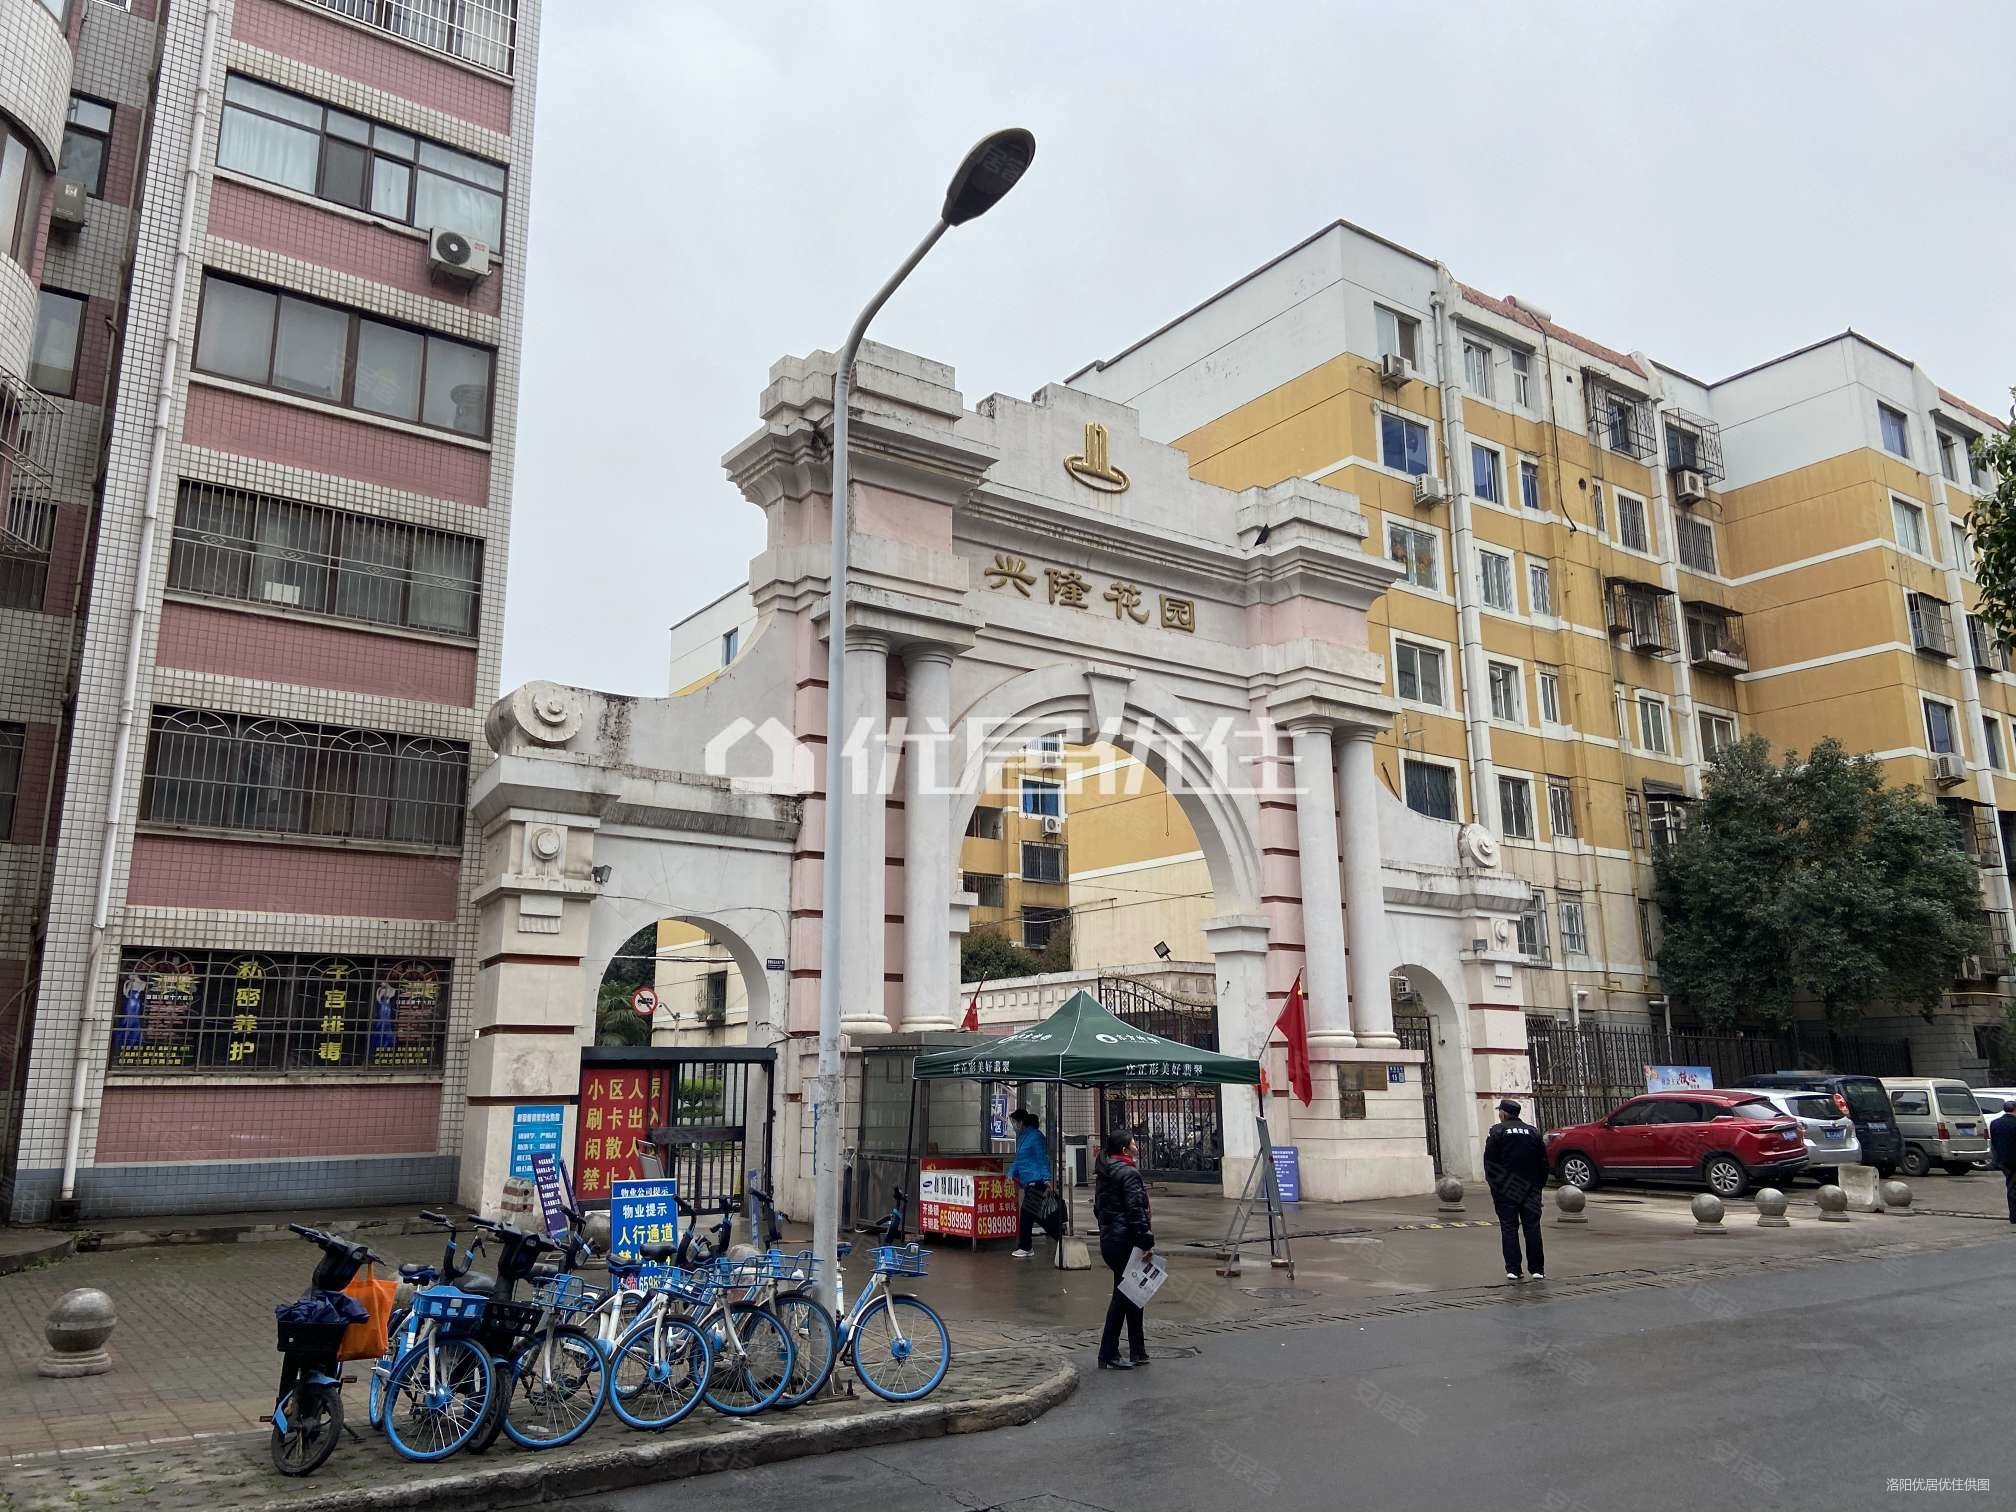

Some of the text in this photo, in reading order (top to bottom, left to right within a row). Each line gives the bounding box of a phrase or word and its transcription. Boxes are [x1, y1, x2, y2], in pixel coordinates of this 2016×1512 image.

[984, 553, 1196, 633] 兴隆花园
[229, 961, 263, 1062] 私密养护
[319, 964, 349, 1062] 子宫排毒
[588, 1078, 661, 1101] 小区人员
[586, 1106, 659, 1130] 刷卡出入
[585, 1136, 655, 1160] 闲散人
[623, 1202, 668, 1219] 物业提示
[940, 1209, 972, 1230] 65989898
[618, 1222, 674, 1247] 人行通道
[977, 1215, 1017, 1234] 65989898
